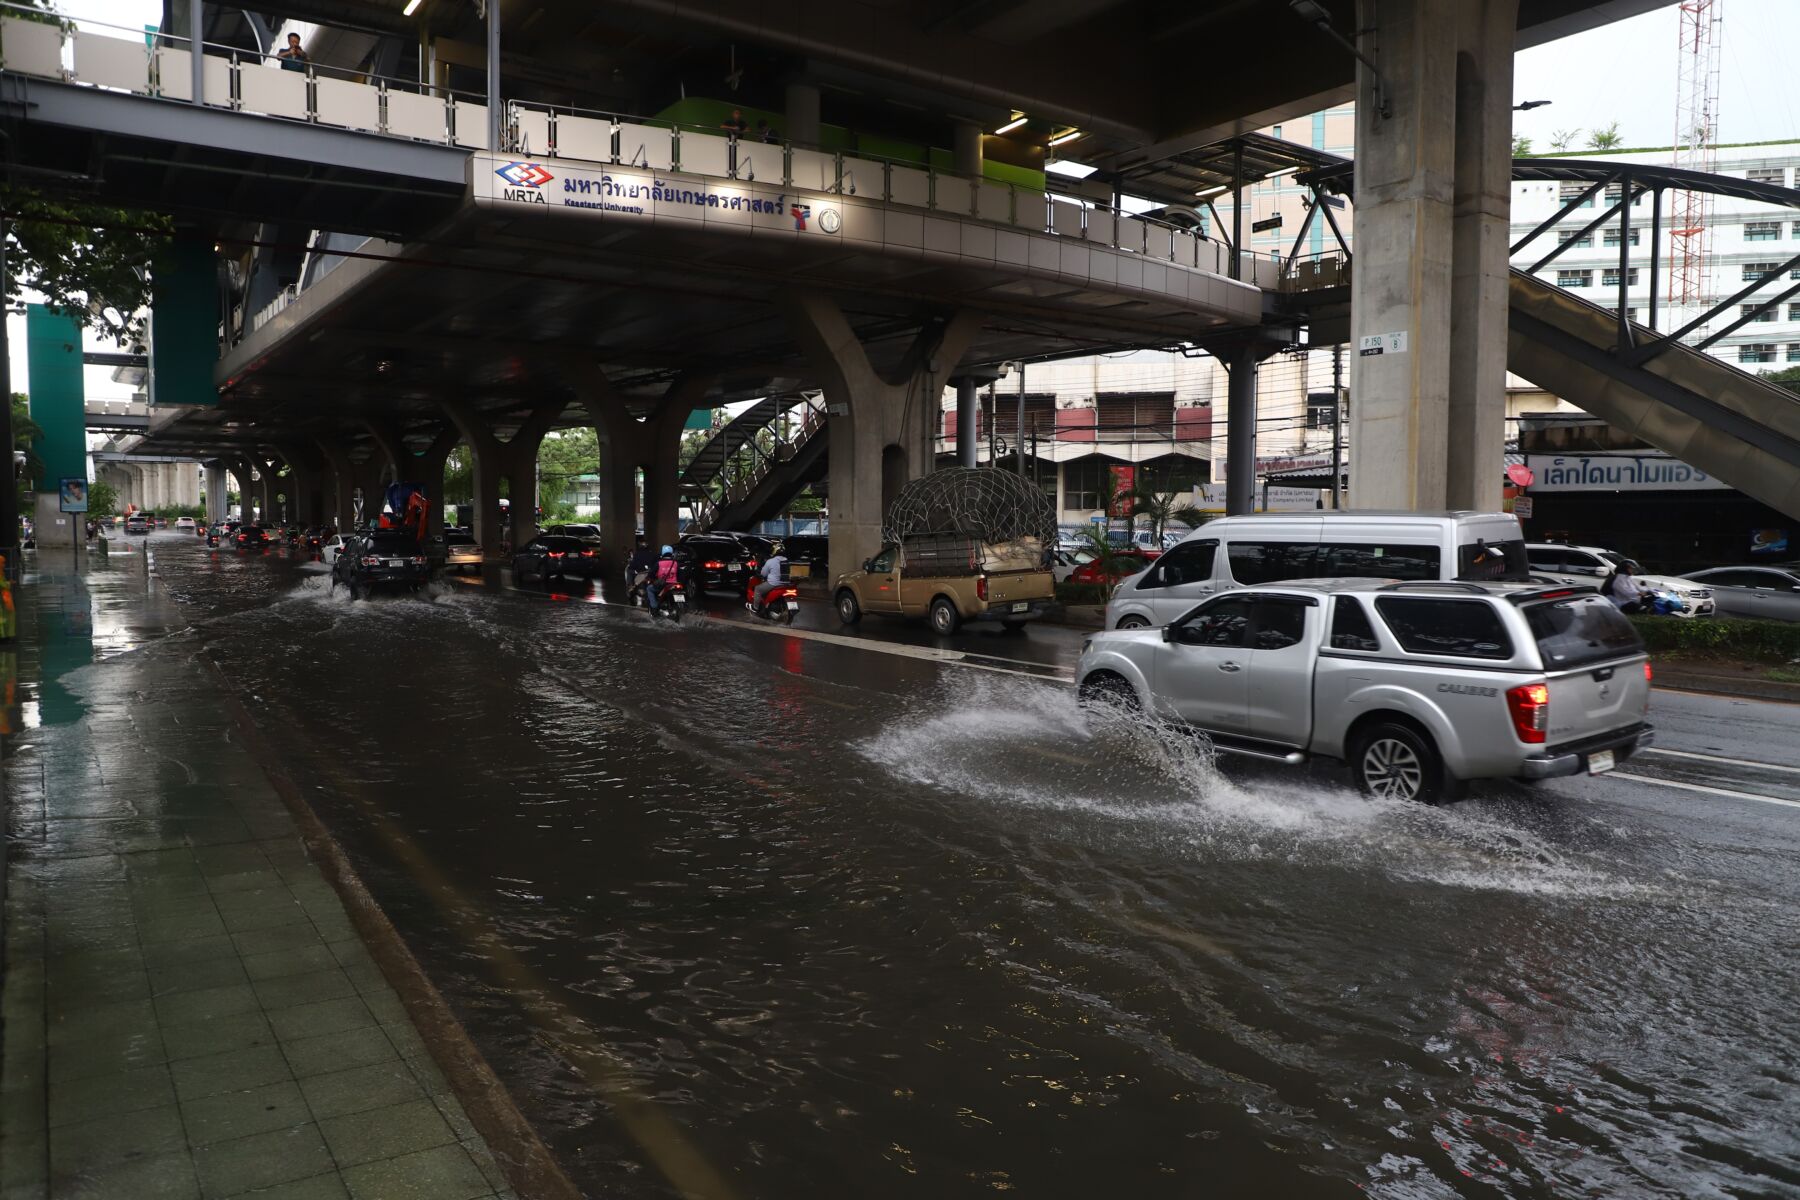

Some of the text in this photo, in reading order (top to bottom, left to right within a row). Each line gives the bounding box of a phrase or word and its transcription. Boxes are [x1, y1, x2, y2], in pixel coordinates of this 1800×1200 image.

[504, 188, 545, 204] MRTA
[564, 175, 785, 215] มหาวิทยาลัยเกษตรศาสตร์
[564, 198, 643, 215] Kasetsart University
[1436, 683, 1499, 698] CALIBRE
